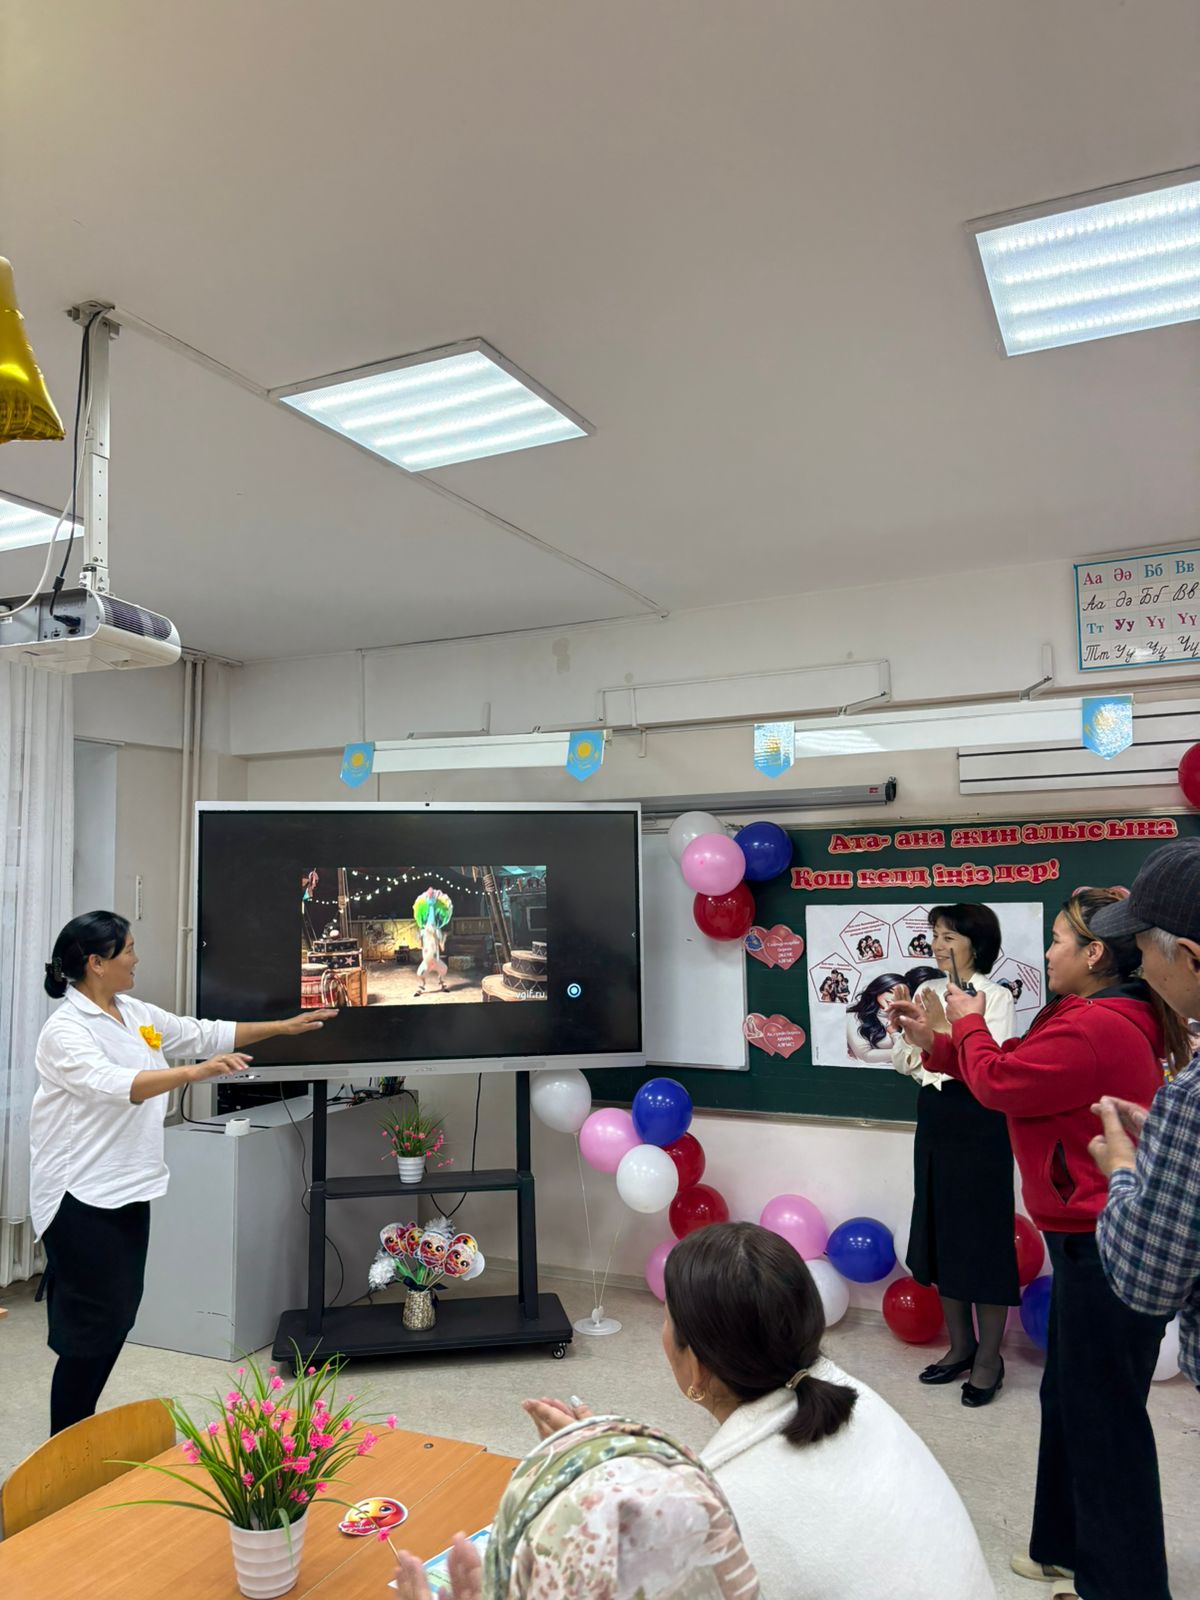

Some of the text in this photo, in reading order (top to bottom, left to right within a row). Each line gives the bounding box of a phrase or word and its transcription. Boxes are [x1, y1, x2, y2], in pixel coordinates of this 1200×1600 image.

[1083, 560, 1195, 586] Аа Әә Бб Вв
[1082, 594, 1106, 612] Аа
[1139, 585, 1170, 605] Бб
[1172, 581, 1200, 601] Вв
[1086, 623, 1105, 634] Тт
[897, 830, 944, 846] ана
